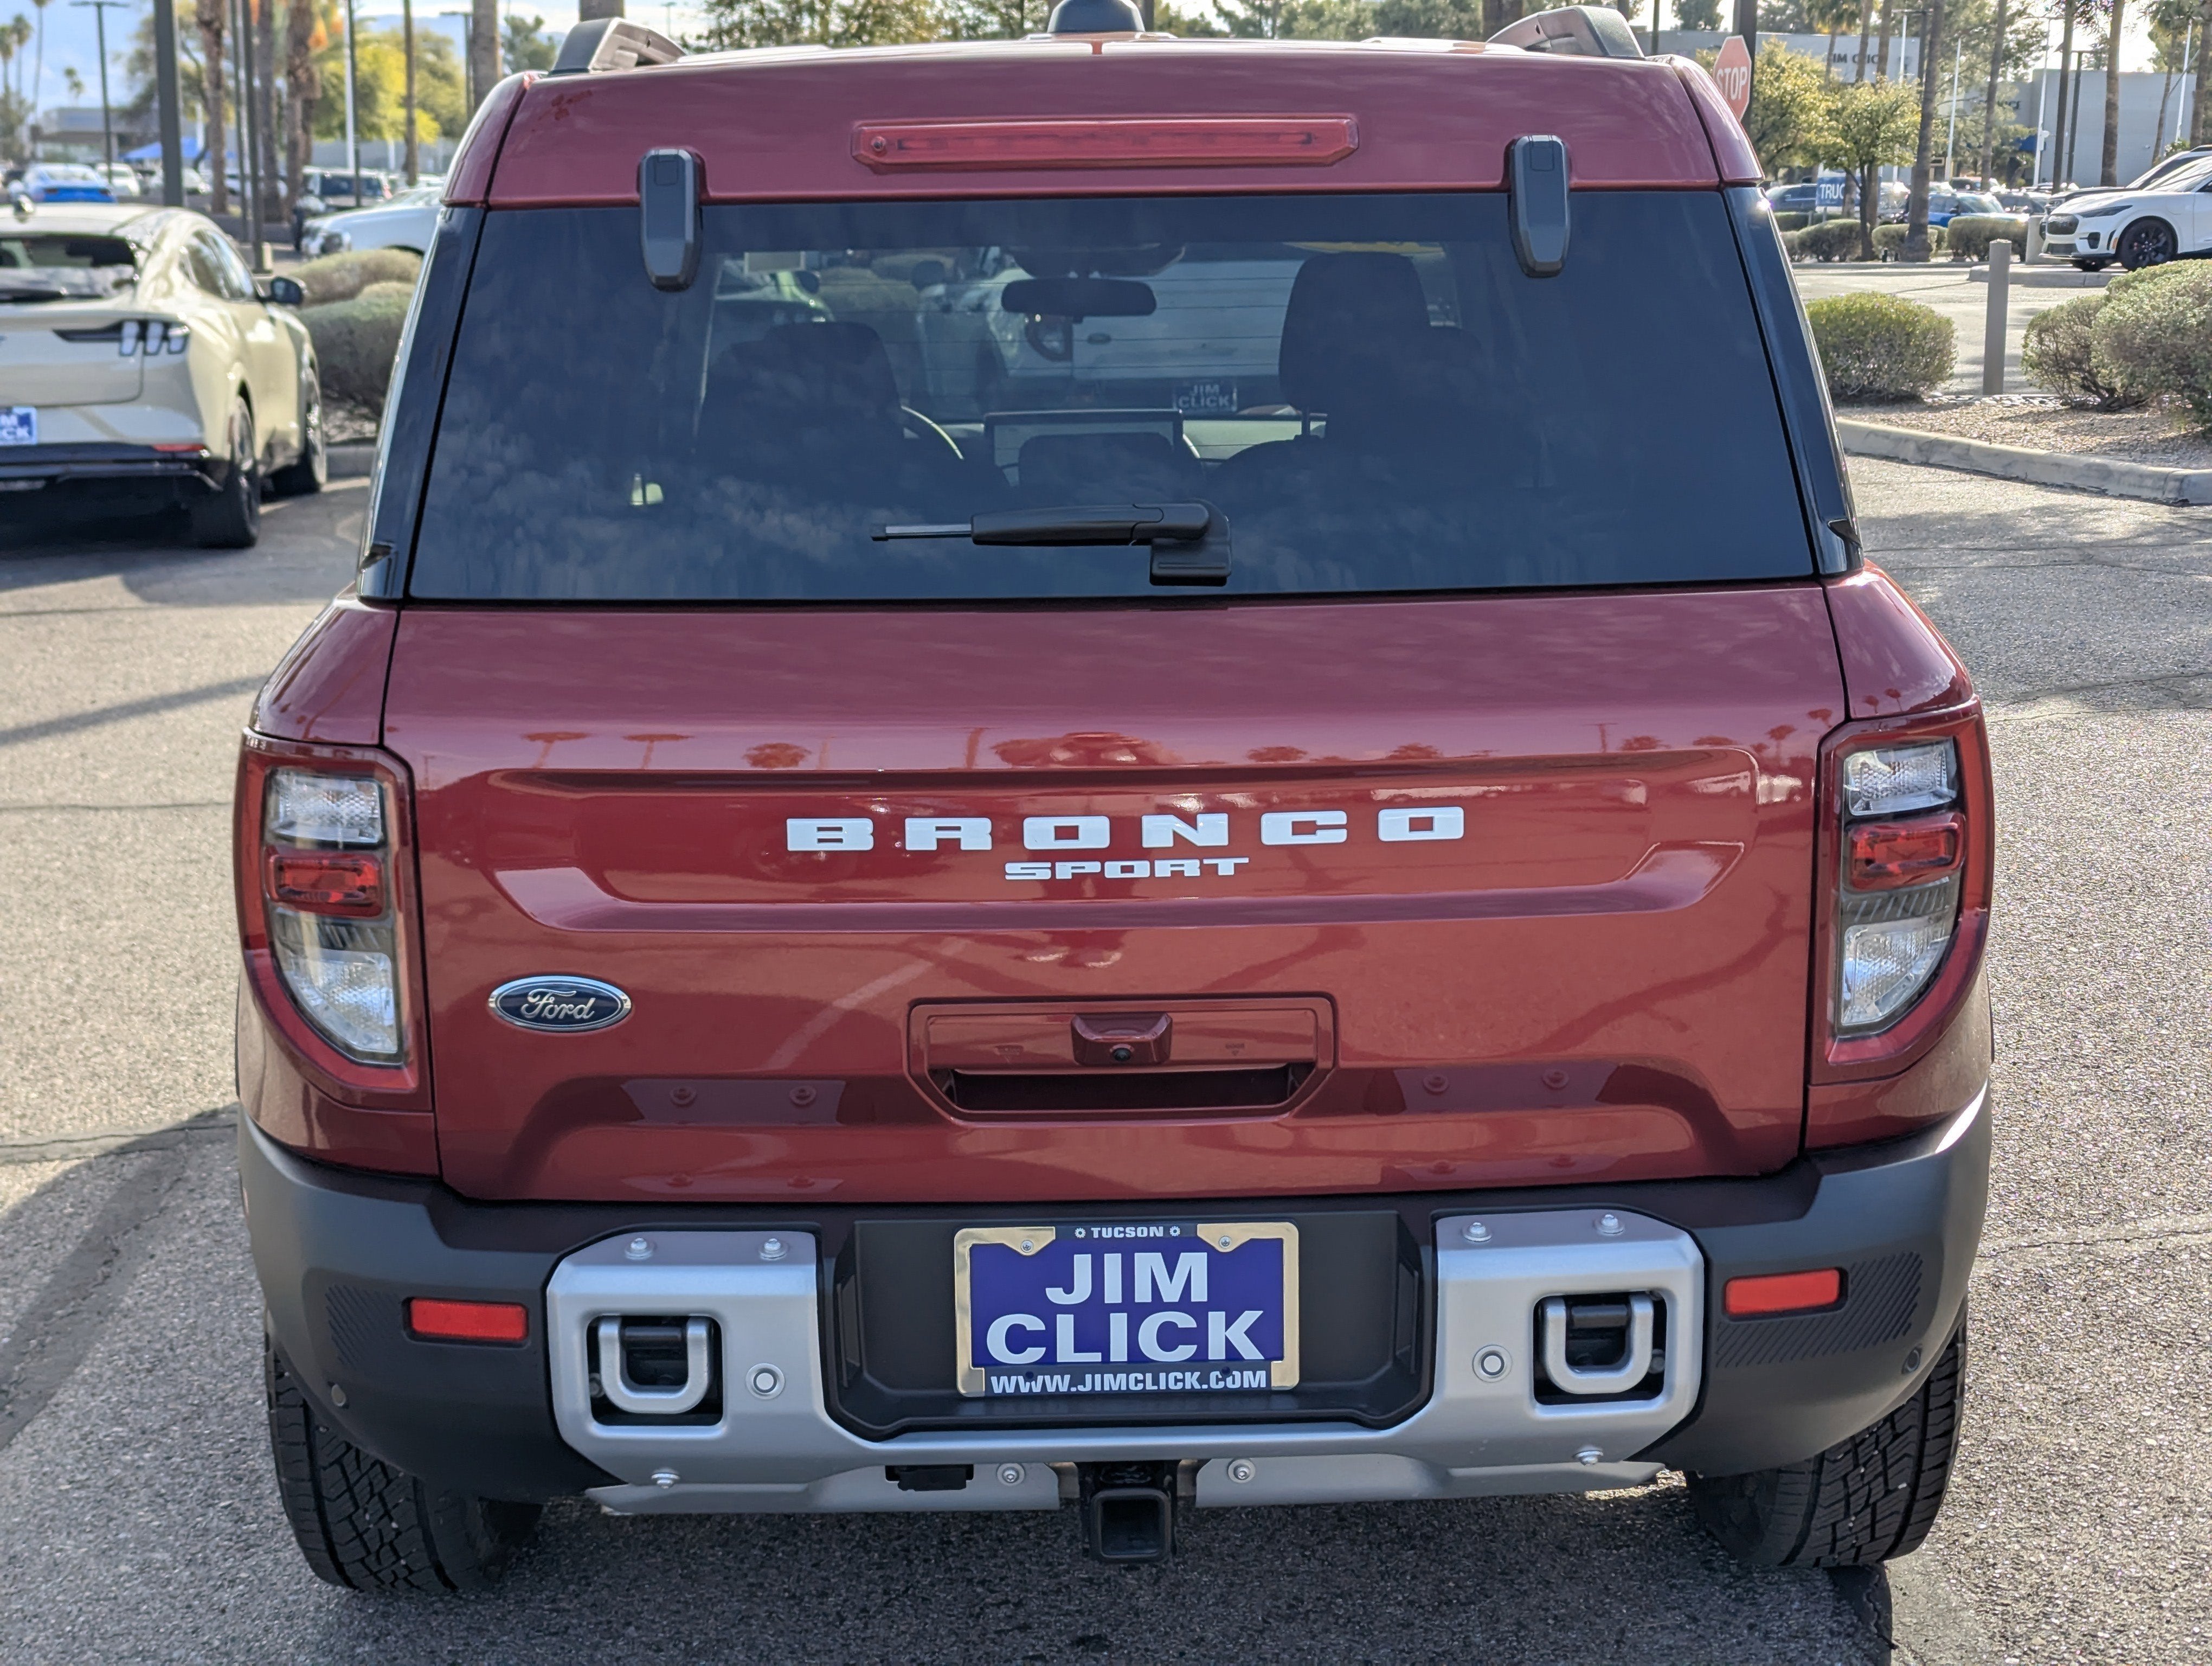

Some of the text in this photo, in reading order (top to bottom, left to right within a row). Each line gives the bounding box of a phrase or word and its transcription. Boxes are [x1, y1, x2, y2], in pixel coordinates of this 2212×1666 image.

[1831, 53, 1847, 63] IM
[1716, 67, 1747, 100] STOP
[1178, 395, 1230, 407] CLICK
[1189, 384, 1219, 395] JIM
[787, 806, 1464, 851] BRONCO
[1005, 857, 1249, 880] SPORT
[520, 988, 586, 1020] Ford
[1091, 1226, 1164, 1238] TUCSON
[1045, 1252, 1208, 1305] JIM
[986, 1310, 1265, 1364] CLICK
[991, 1370, 1266, 1394] WWW.JIMCLICK.COM
